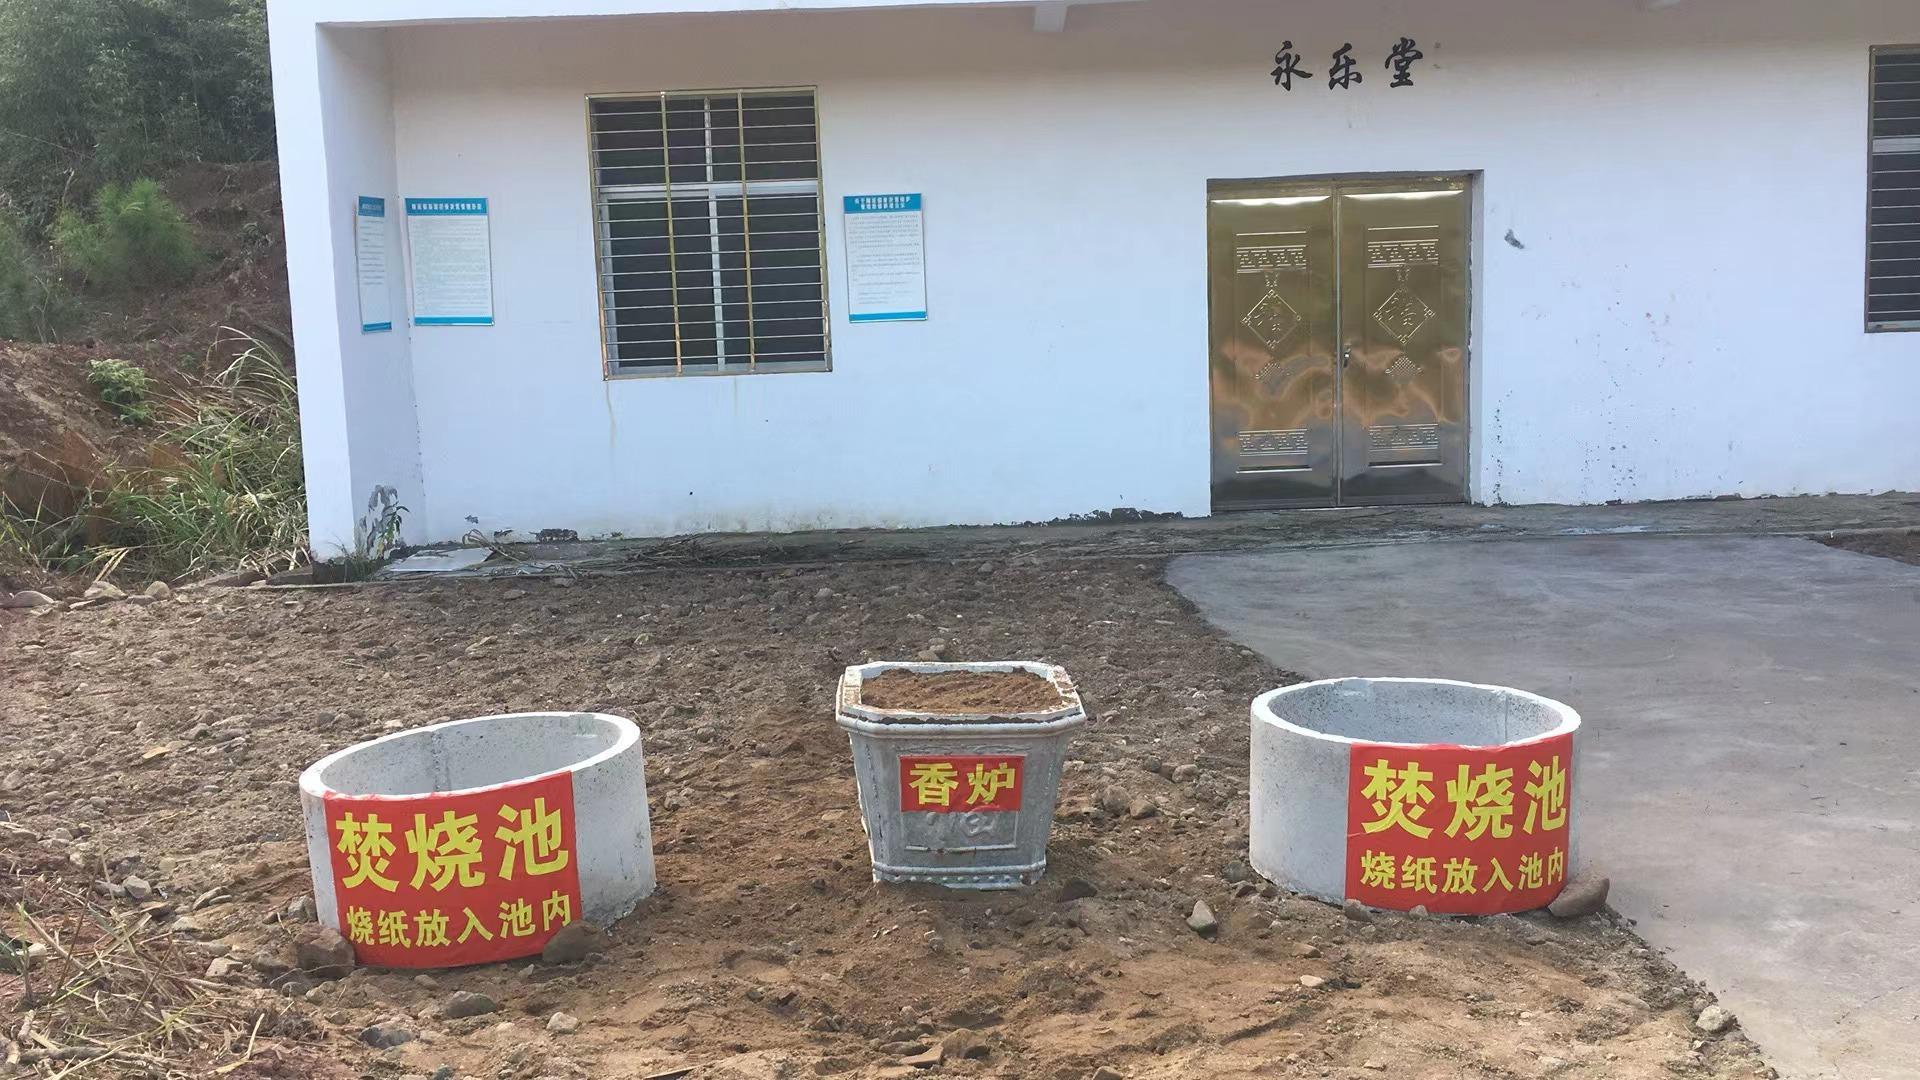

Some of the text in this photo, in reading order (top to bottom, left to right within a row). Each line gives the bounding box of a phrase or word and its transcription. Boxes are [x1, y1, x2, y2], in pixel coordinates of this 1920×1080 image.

[1271, 37, 1423, 91] 永乐堂
[909, 762, 1015, 807] 香炉
[1361, 755, 1567, 841] 焚烧池
[335, 797, 569, 893] 焚烧池
[1360, 847, 1564, 895] 烧纸放入池内
[346, 890, 571, 948] 烧纸放入池内
